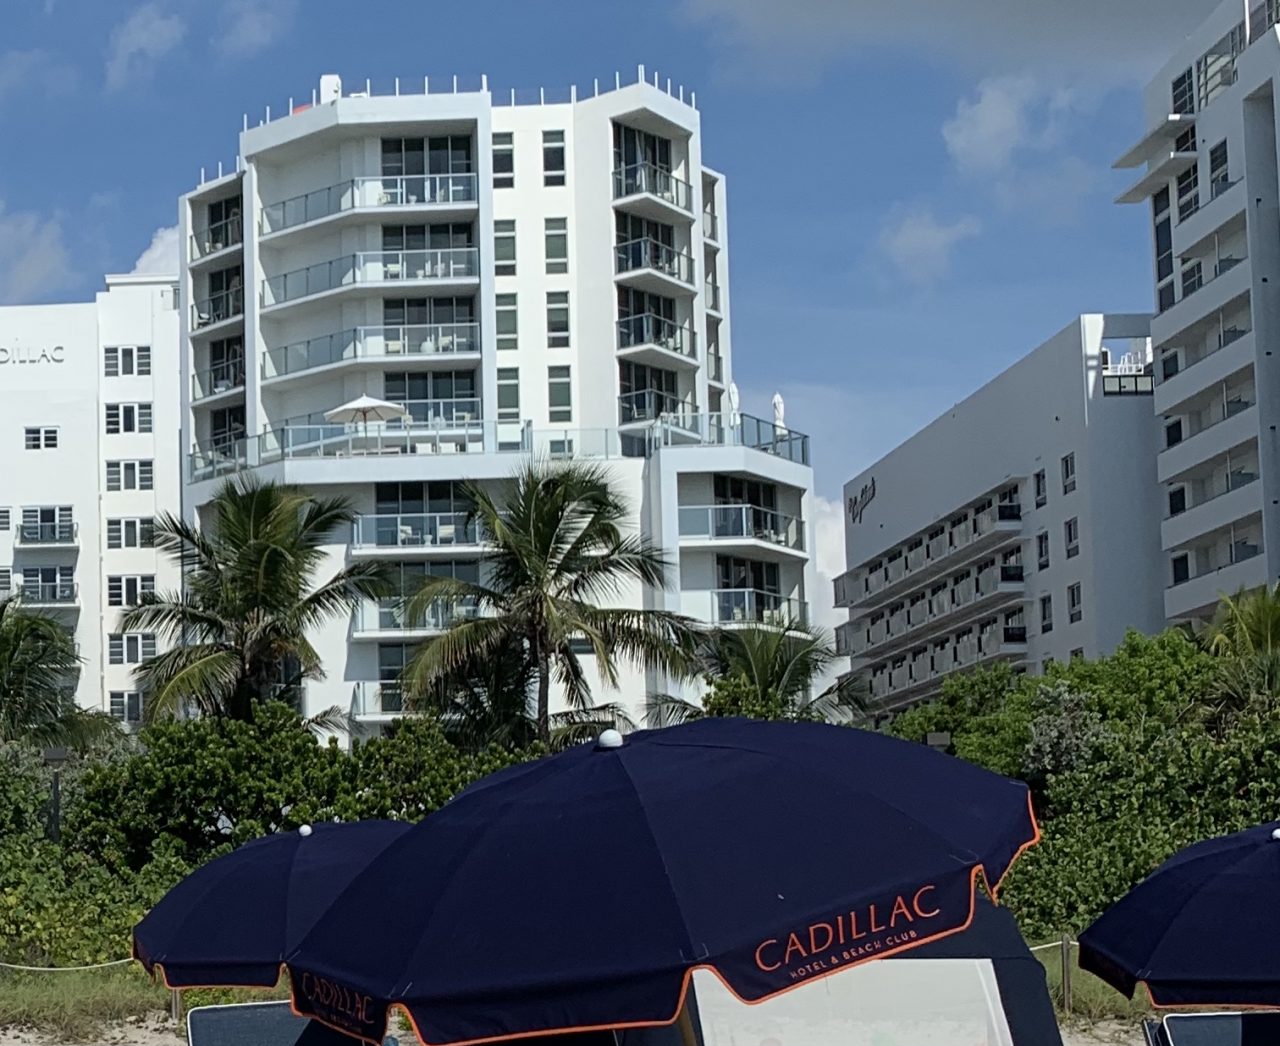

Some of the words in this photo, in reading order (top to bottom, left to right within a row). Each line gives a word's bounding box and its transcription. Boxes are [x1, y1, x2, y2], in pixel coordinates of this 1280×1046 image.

[755, 885, 941, 971] CADILLAC
[790, 960, 827, 979] HOTEL
[830, 955, 839, 964] &
[843, 941, 882, 960] BEACH
[886, 930, 918, 946] CLUB
[302, 972, 375, 1024] CADILLAC
